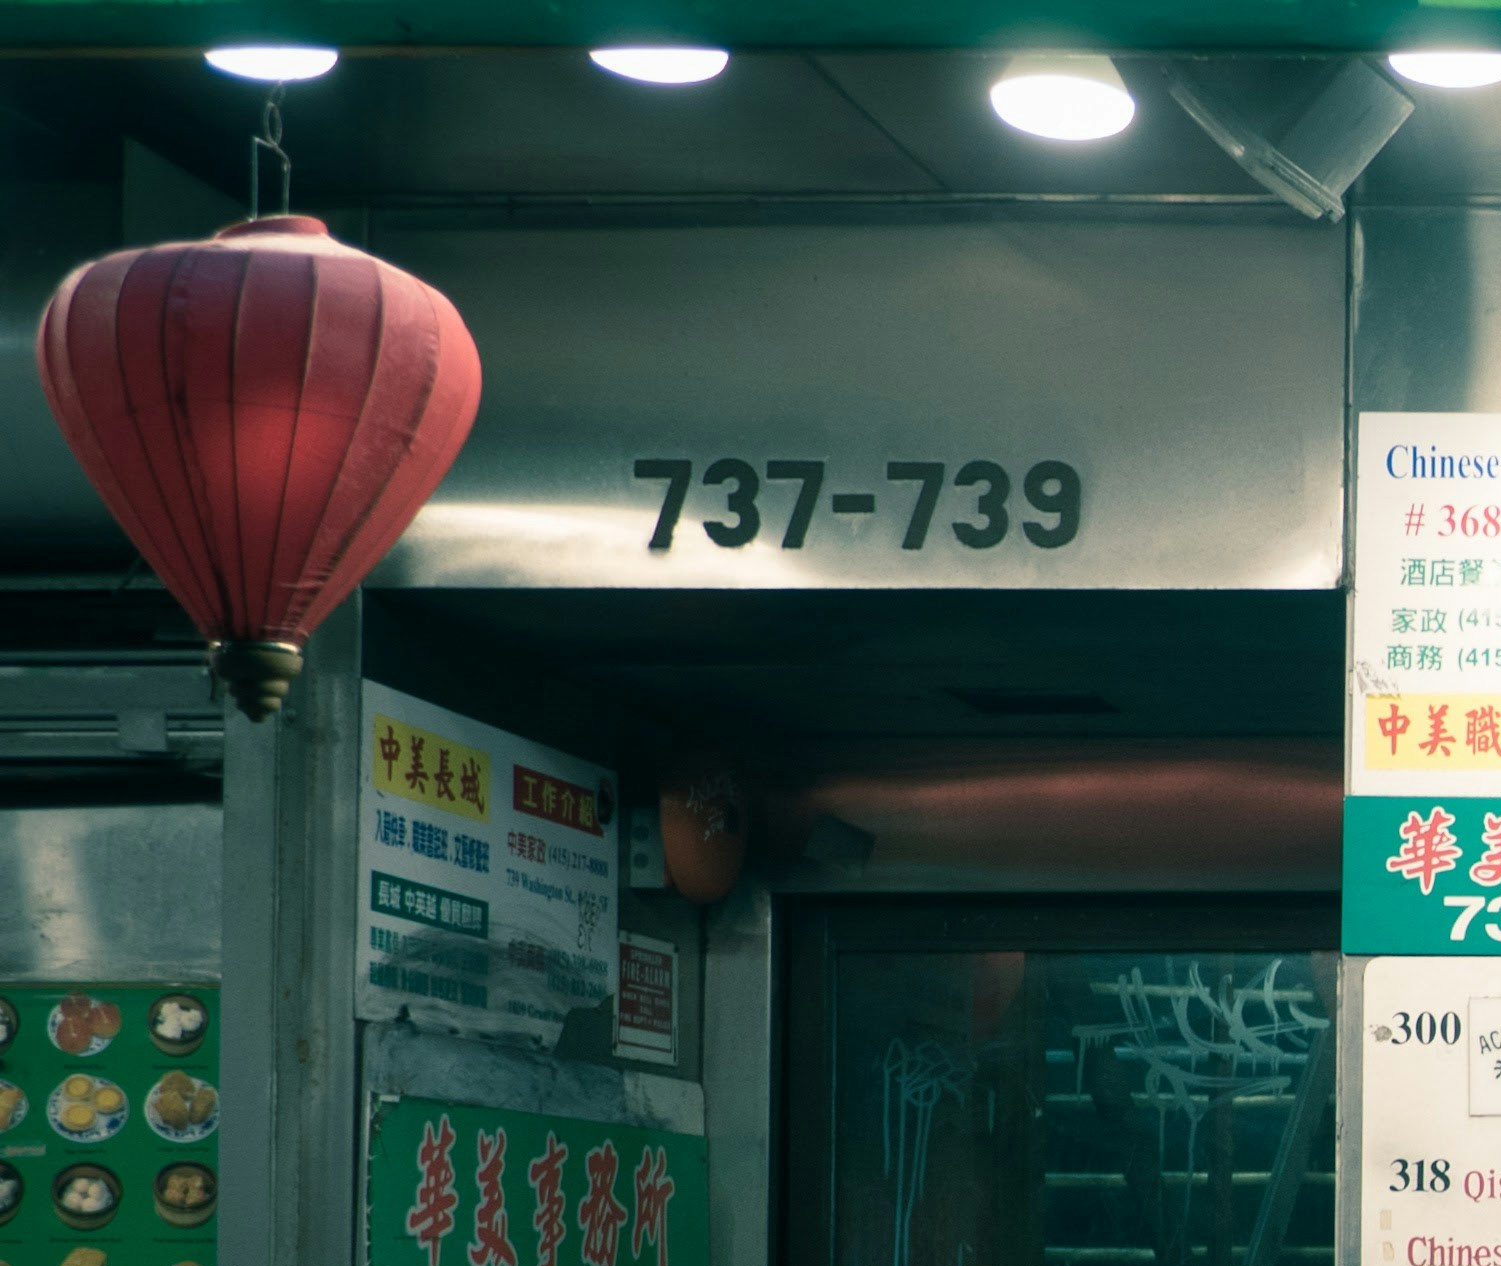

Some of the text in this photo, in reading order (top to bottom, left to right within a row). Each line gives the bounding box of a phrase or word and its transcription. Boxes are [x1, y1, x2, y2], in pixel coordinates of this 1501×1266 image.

[1386, 444, 1500, 481] Chinese
[634, 458, 1081, 551] 737-739
[1437, 503, 1501, 539] 368
[1391, 607, 1448, 635] 家政
[1386, 644, 1444, 672] 商務
[378, 724, 486, 815] 中美長城
[522, 774, 597, 829] 工作介紹
[1389, 1010, 1462, 1046] 300
[1388, 1158, 1451, 1194] 318
